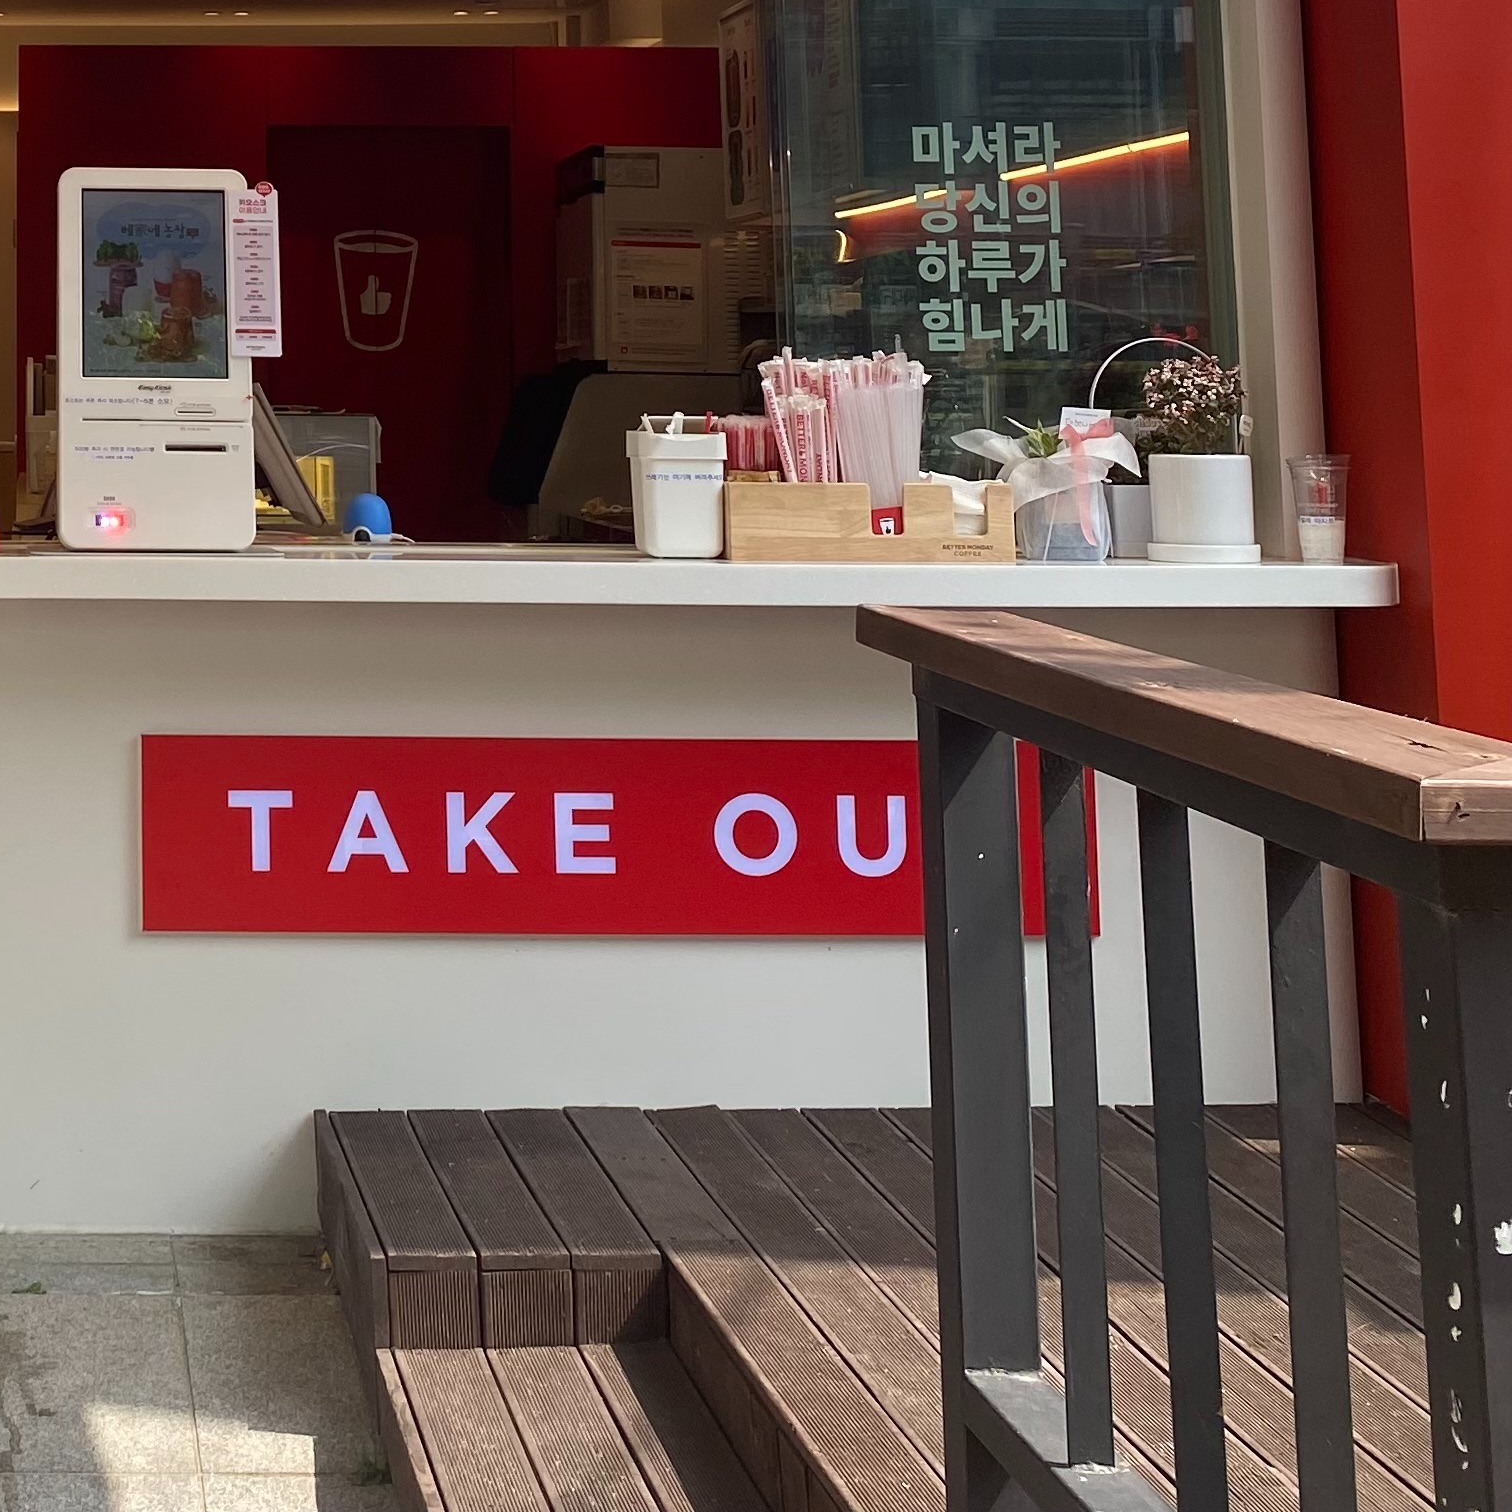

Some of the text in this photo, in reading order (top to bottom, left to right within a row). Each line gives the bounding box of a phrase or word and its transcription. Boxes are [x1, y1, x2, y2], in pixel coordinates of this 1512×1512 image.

[911, 121, 1061, 175] 마셔라
[915, 180, 1062, 233] 당신의
[915, 239, 1067, 293] 하루가
[919, 299, 1069, 352] 힘나게
[227, 789, 908, 878] TAKE OU
